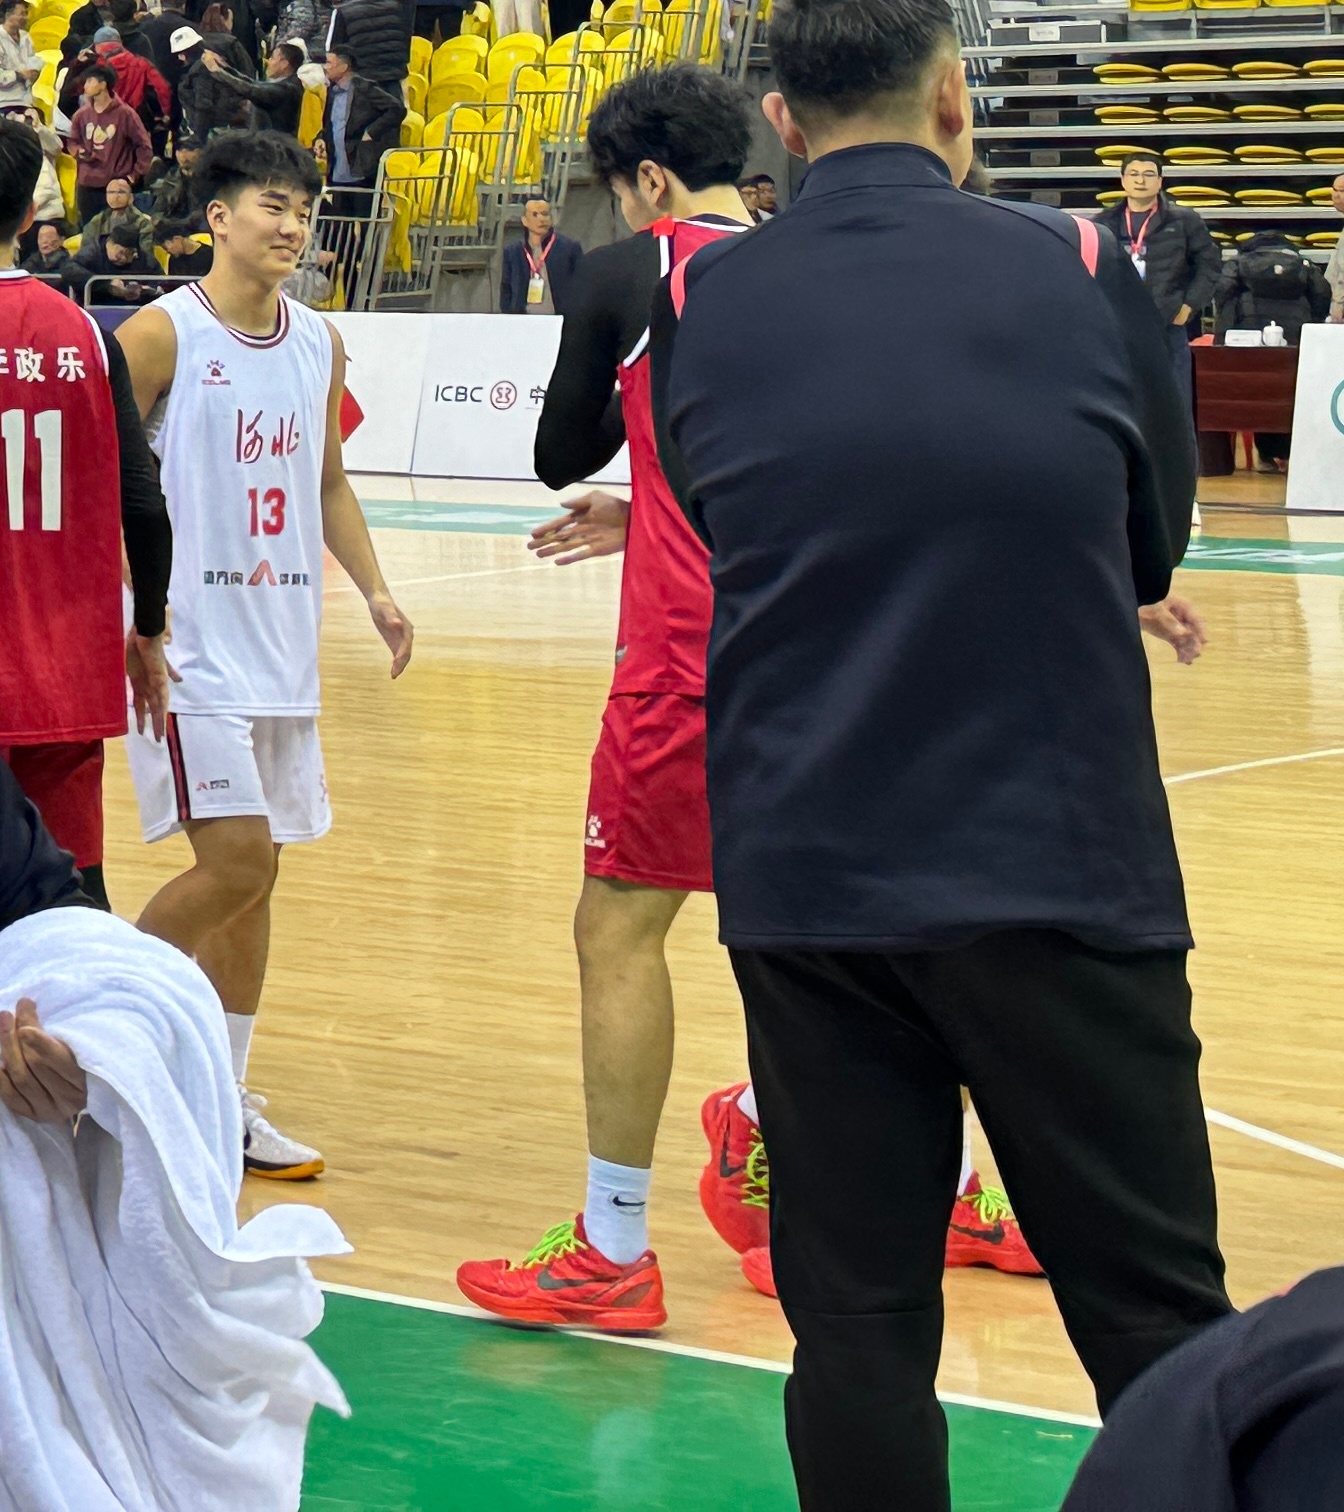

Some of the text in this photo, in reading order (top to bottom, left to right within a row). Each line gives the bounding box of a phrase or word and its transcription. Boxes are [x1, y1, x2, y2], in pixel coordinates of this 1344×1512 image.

[435, 384, 483, 403] ICBC
[0, 409, 63, 532] 11
[248, 487, 286, 537] 13
